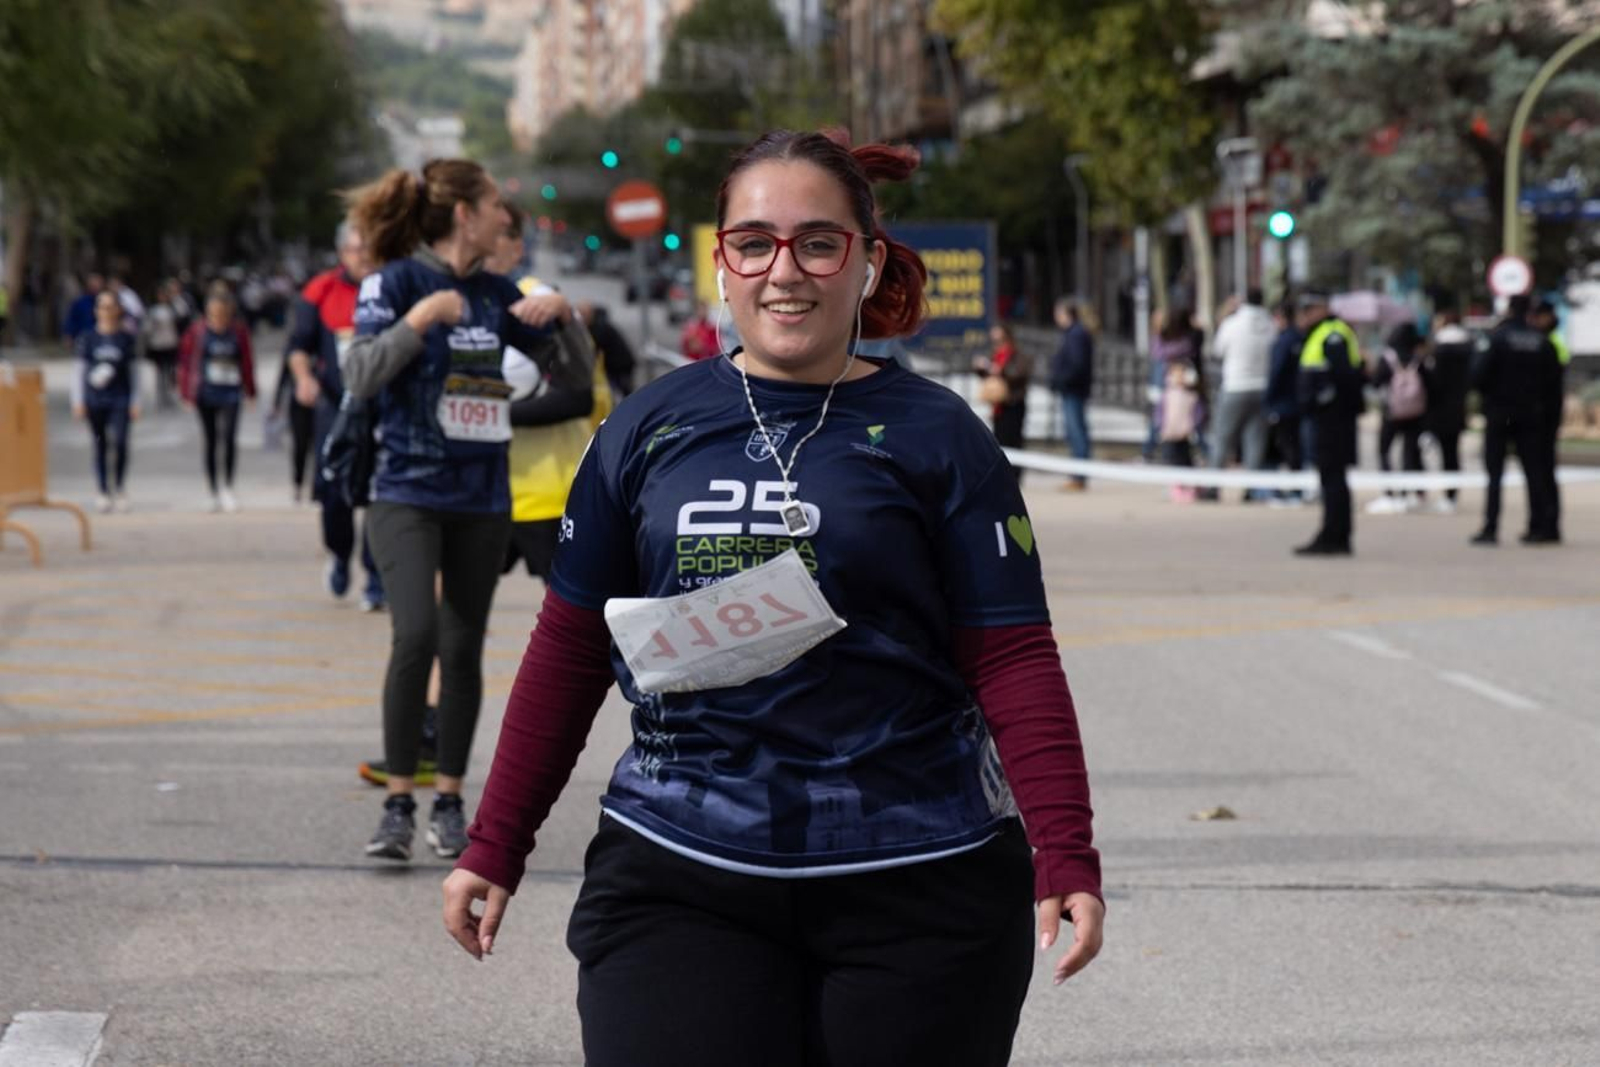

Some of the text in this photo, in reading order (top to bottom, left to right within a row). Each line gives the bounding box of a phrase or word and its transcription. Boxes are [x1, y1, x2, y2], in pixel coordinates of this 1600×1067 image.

[448, 327, 500, 350] 25
[449, 400, 499, 427] 1091
[677, 480, 821, 536] 25
[677, 537, 816, 558] CARRERA
[678, 555, 818, 575] POPULR
